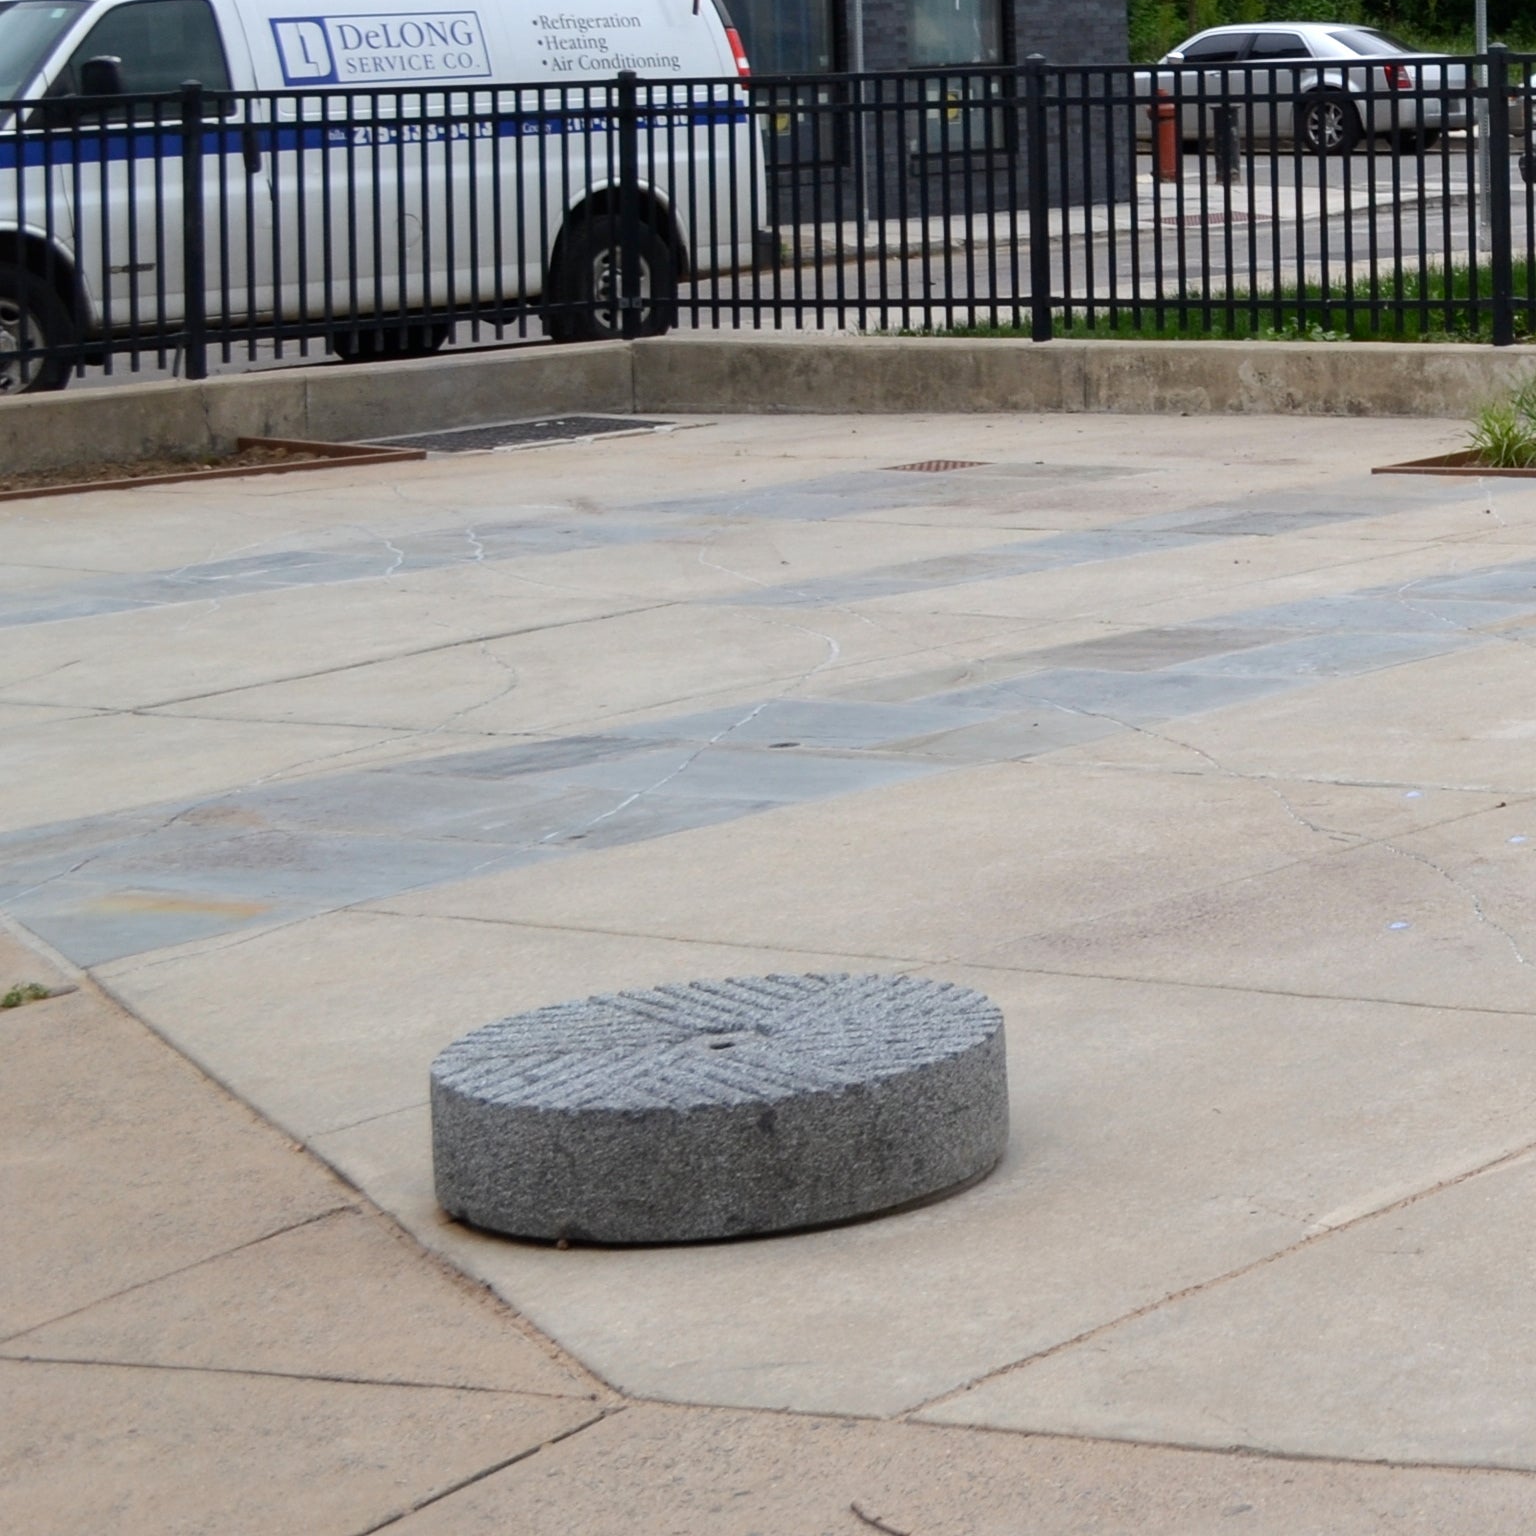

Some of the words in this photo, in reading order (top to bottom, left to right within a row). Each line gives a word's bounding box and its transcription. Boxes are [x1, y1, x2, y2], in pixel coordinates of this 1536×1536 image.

[541, 13, 641, 32] Refrigeration
[337, 20, 474, 52] DeLONG
[546, 35, 608, 53] Heating
[346, 54, 435, 75] SERVICE
[443, 52, 480, 71] CO.
[551, 56, 574, 71] Air
[578, 52, 681, 73] Conditioning
